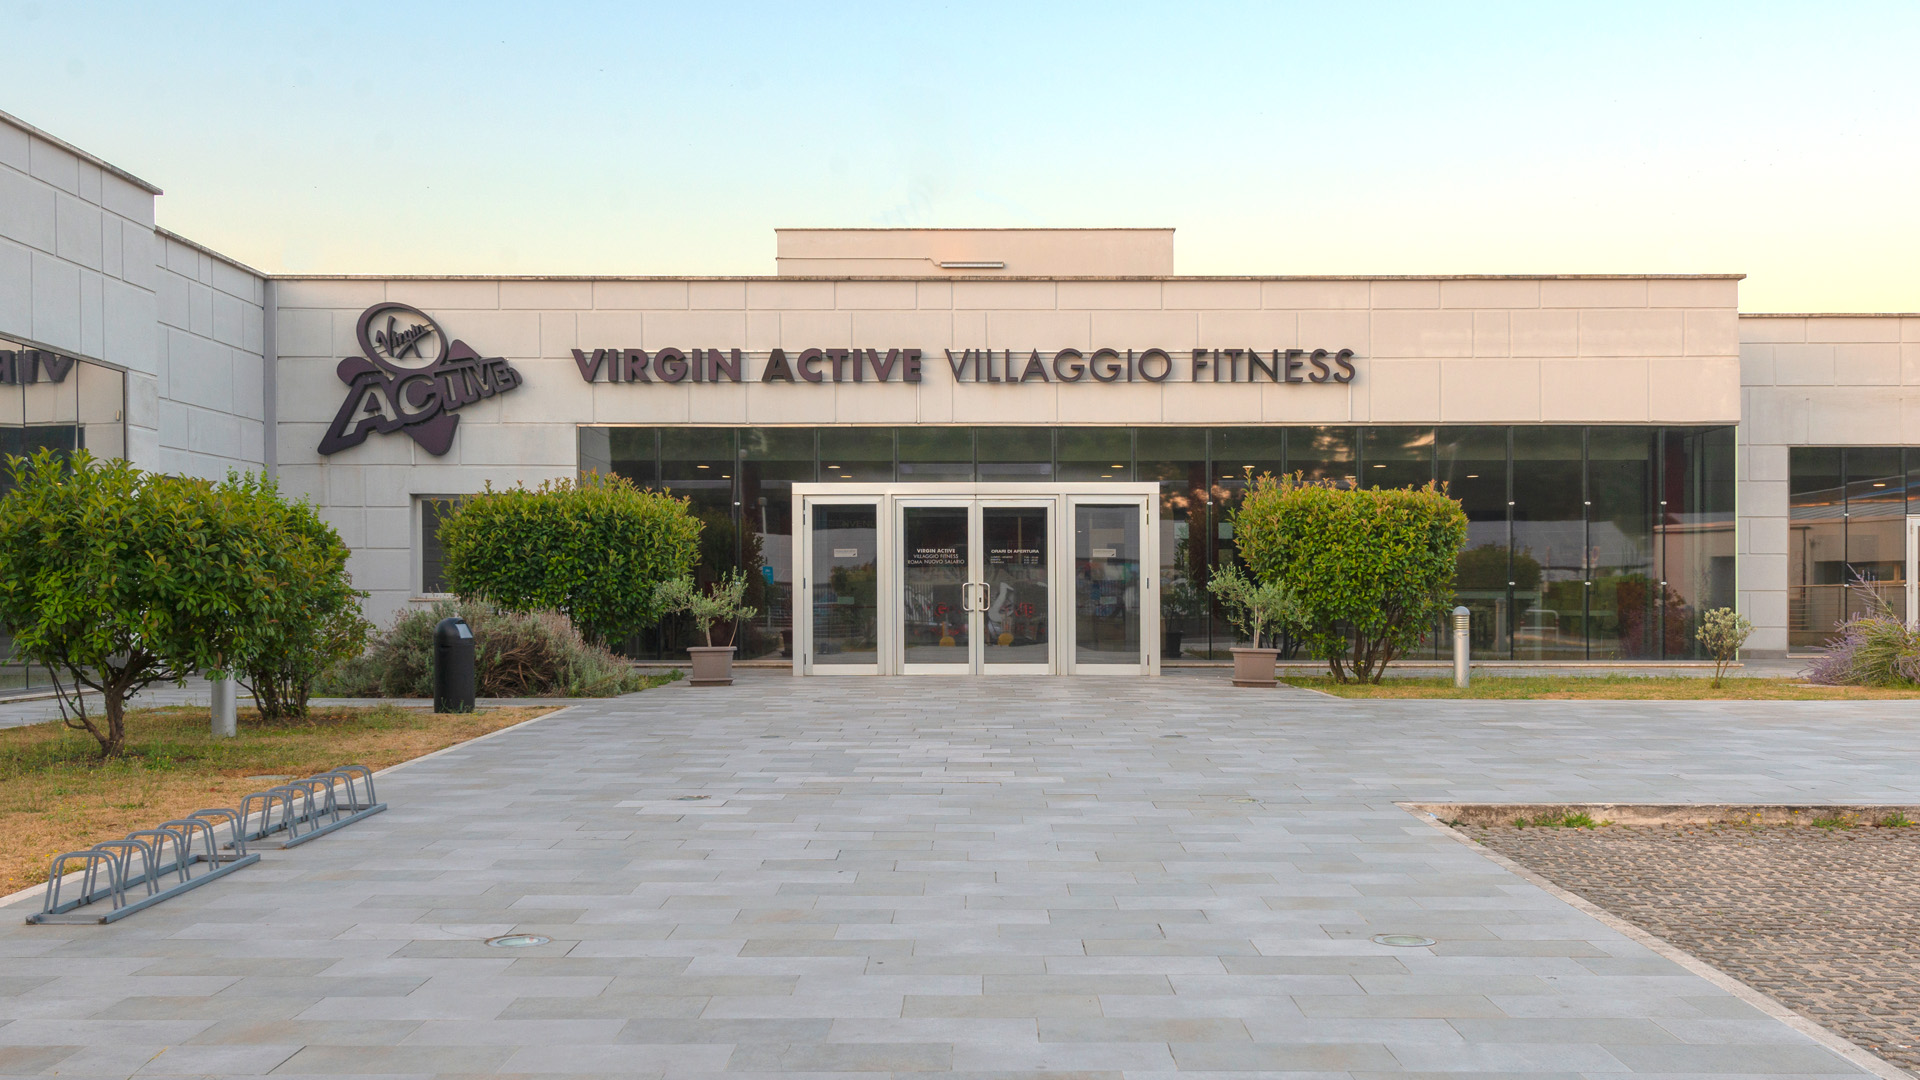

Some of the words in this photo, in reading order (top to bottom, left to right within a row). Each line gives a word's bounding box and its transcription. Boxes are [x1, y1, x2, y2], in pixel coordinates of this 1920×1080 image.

[375, 315, 431, 360] Virgin
[571, 347, 741, 383] VIRGIN
[761, 347, 922, 383] ACTIVE
[944, 347, 1172, 384] VILLAGGIO
[1192, 347, 1357, 384] FITNESS
[316, 356, 519, 456] ACTIVE
